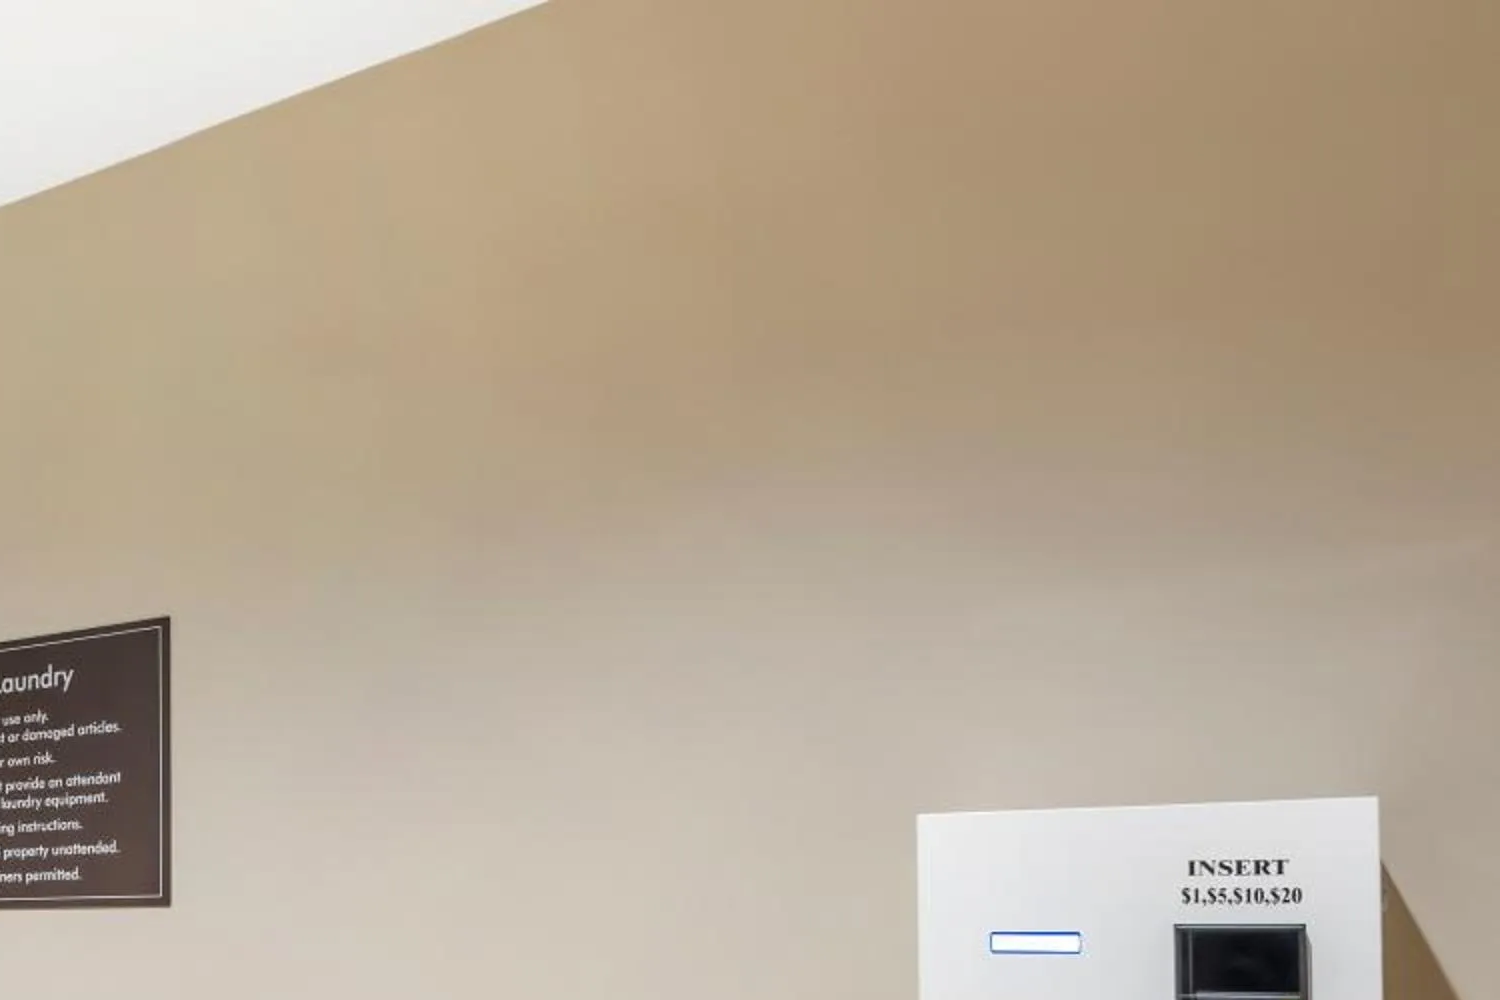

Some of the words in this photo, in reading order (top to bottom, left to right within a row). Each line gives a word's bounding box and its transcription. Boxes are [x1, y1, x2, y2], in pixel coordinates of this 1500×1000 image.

[2, 715, 21, 726] use
[24, 709, 49, 725] only.
[8, 733, 20, 744] or
[22, 725, 75, 742] damaged
[78, 720, 122, 736] articles.
[7, 756, 31, 767] own
[33, 751, 56, 765] risk.
[5, 777, 45, 794] provide
[49, 778, 63, 788] an
[66, 772, 121, 787] attendant
[1, 795, 42, 810] laundry
[45, 792, 108, 808] equipment.
[17, 818, 83, 833] instructions.
[3, 844, 49, 860] property
[51, 839, 121, 855] unattended.
[25, 867, 81, 883] permitted.
[1187, 859, 1290, 877] INSERT
